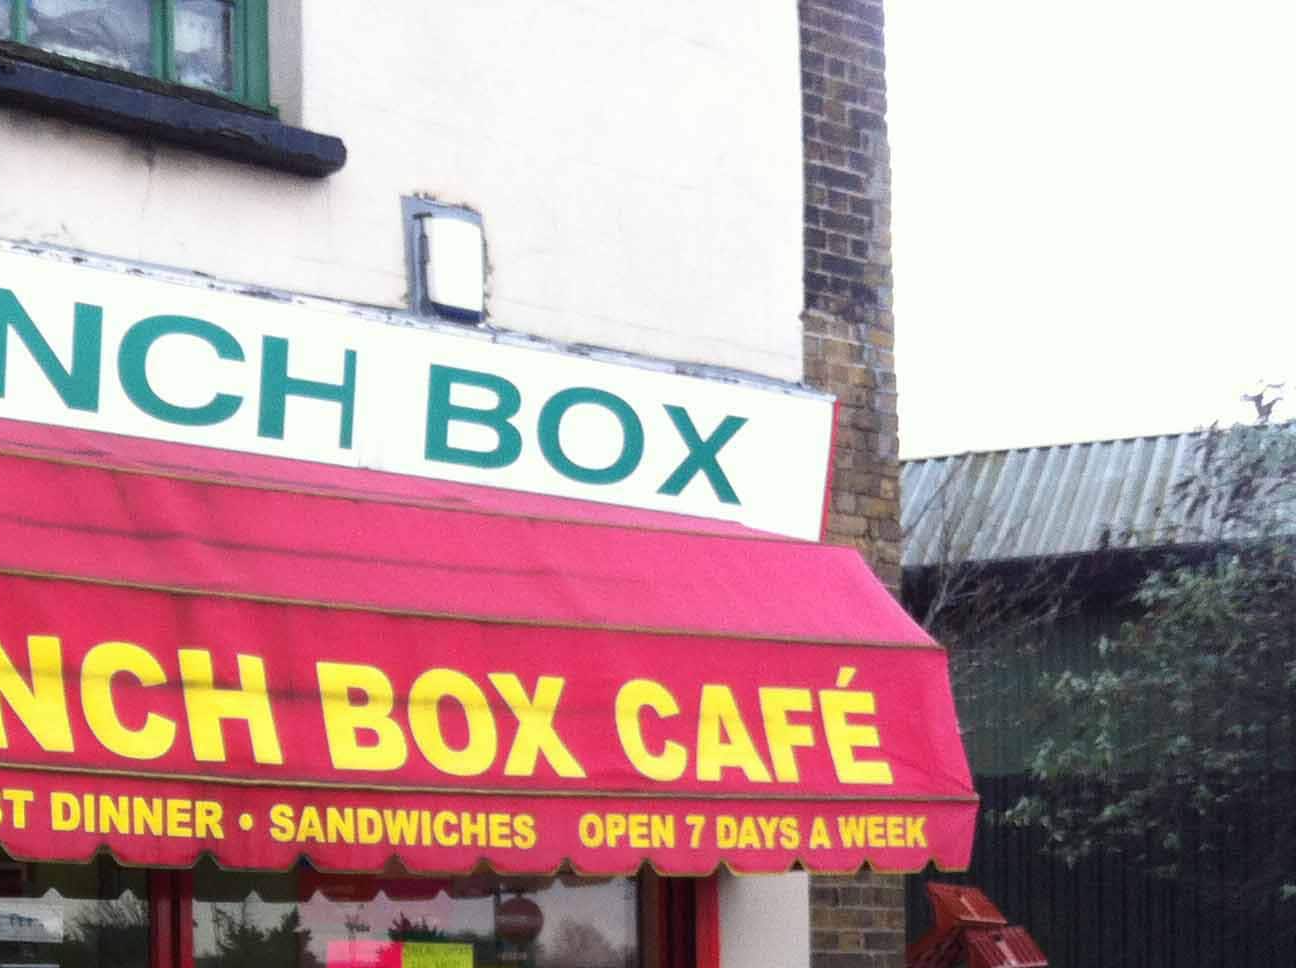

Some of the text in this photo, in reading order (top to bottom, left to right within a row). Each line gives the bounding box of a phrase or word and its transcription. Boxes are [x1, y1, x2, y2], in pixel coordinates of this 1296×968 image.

[424, 363, 746, 505] BOX
[317, 660, 587, 777] BOX
[616, 667, 895, 783] CAFÉ
[50, 791, 225, 840] DINNER
[270, 803, 538, 850] SANDWICHES
[578, 812, 676, 849] OPEN
[687, 814, 706, 849] 7
[715, 815, 802, 850] DAYS
[809, 816, 833, 849] A
[838, 815, 929, 849] WEEK
